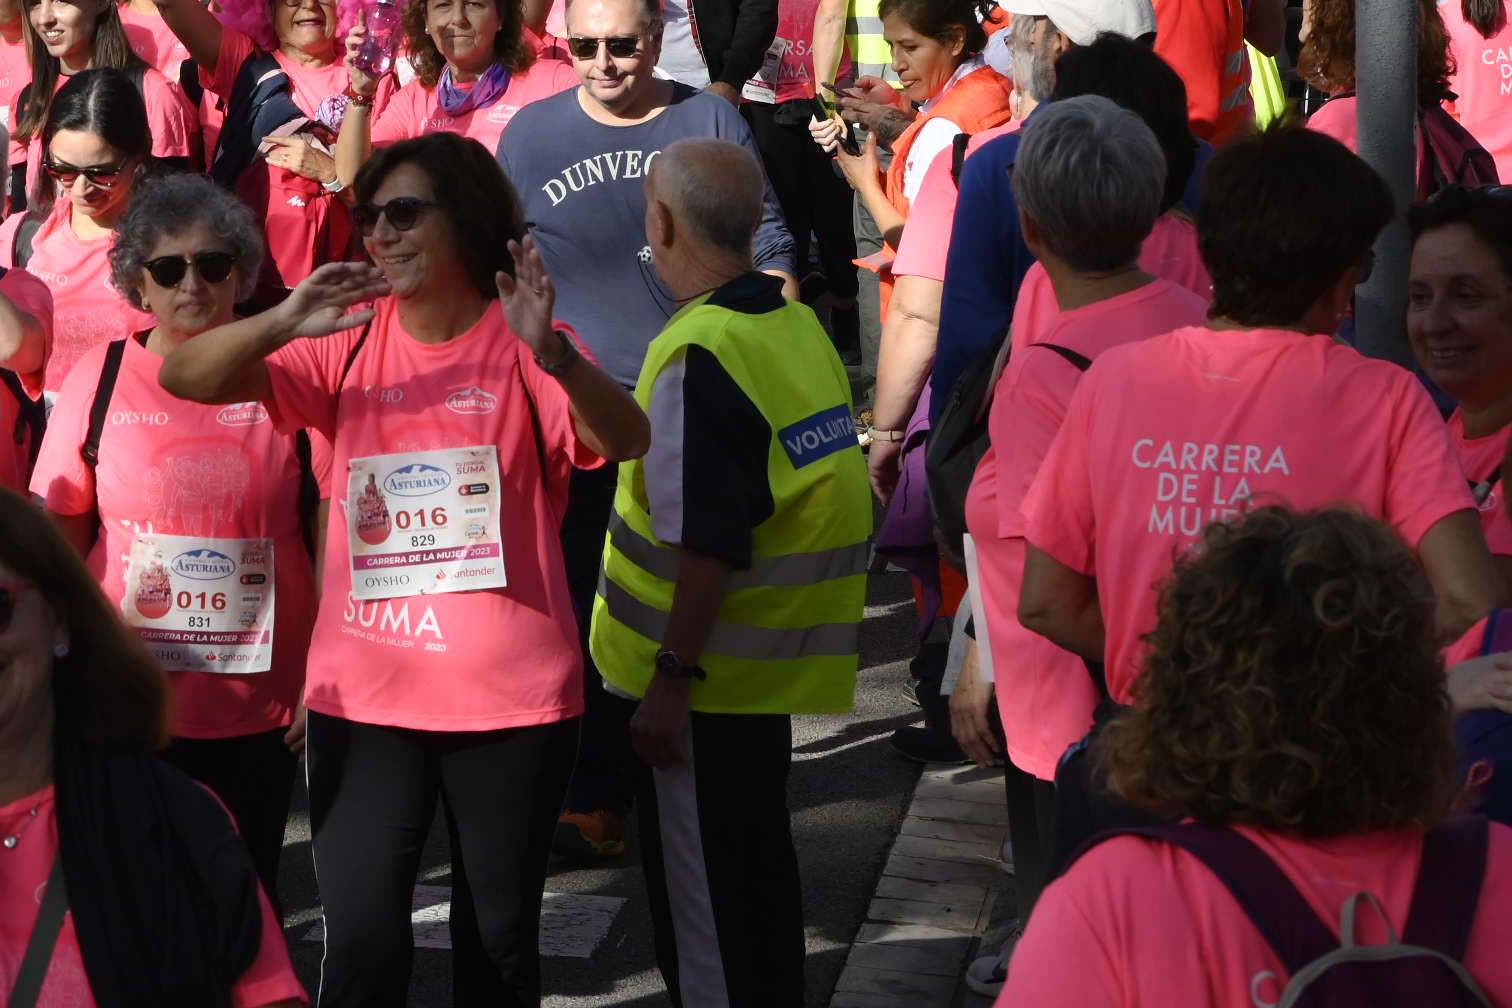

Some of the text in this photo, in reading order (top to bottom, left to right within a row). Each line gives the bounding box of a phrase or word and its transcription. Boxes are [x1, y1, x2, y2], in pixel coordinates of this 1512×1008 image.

[112, 410, 169, 426] OYSHO
[1132, 438, 1291, 475] CARRERA
[456, 464, 487, 475] SUMA
[388, 475, 447, 491] ASTURIANA
[1157, 472, 1255, 506] DE LA
[395, 507, 448, 529] 016
[411, 534, 435, 547] 829
[176, 558, 230, 574] ASTURIANA
[366, 556, 407, 567] CARRERA
[408, 554, 421, 563] DE
[422, 552, 436, 561] LA
[437, 549, 467, 560] MUJER
[365, 574, 410, 588] OYSHO
[176, 591, 227, 610] 016
[187, 616, 211, 628] 831
[343, 590, 444, 640] SUMA
[140, 631, 181, 641] CARRERA
[183, 633, 196, 641] DE
[196, 634, 207, 642] LA
[209, 634, 239, 642] MUJER
